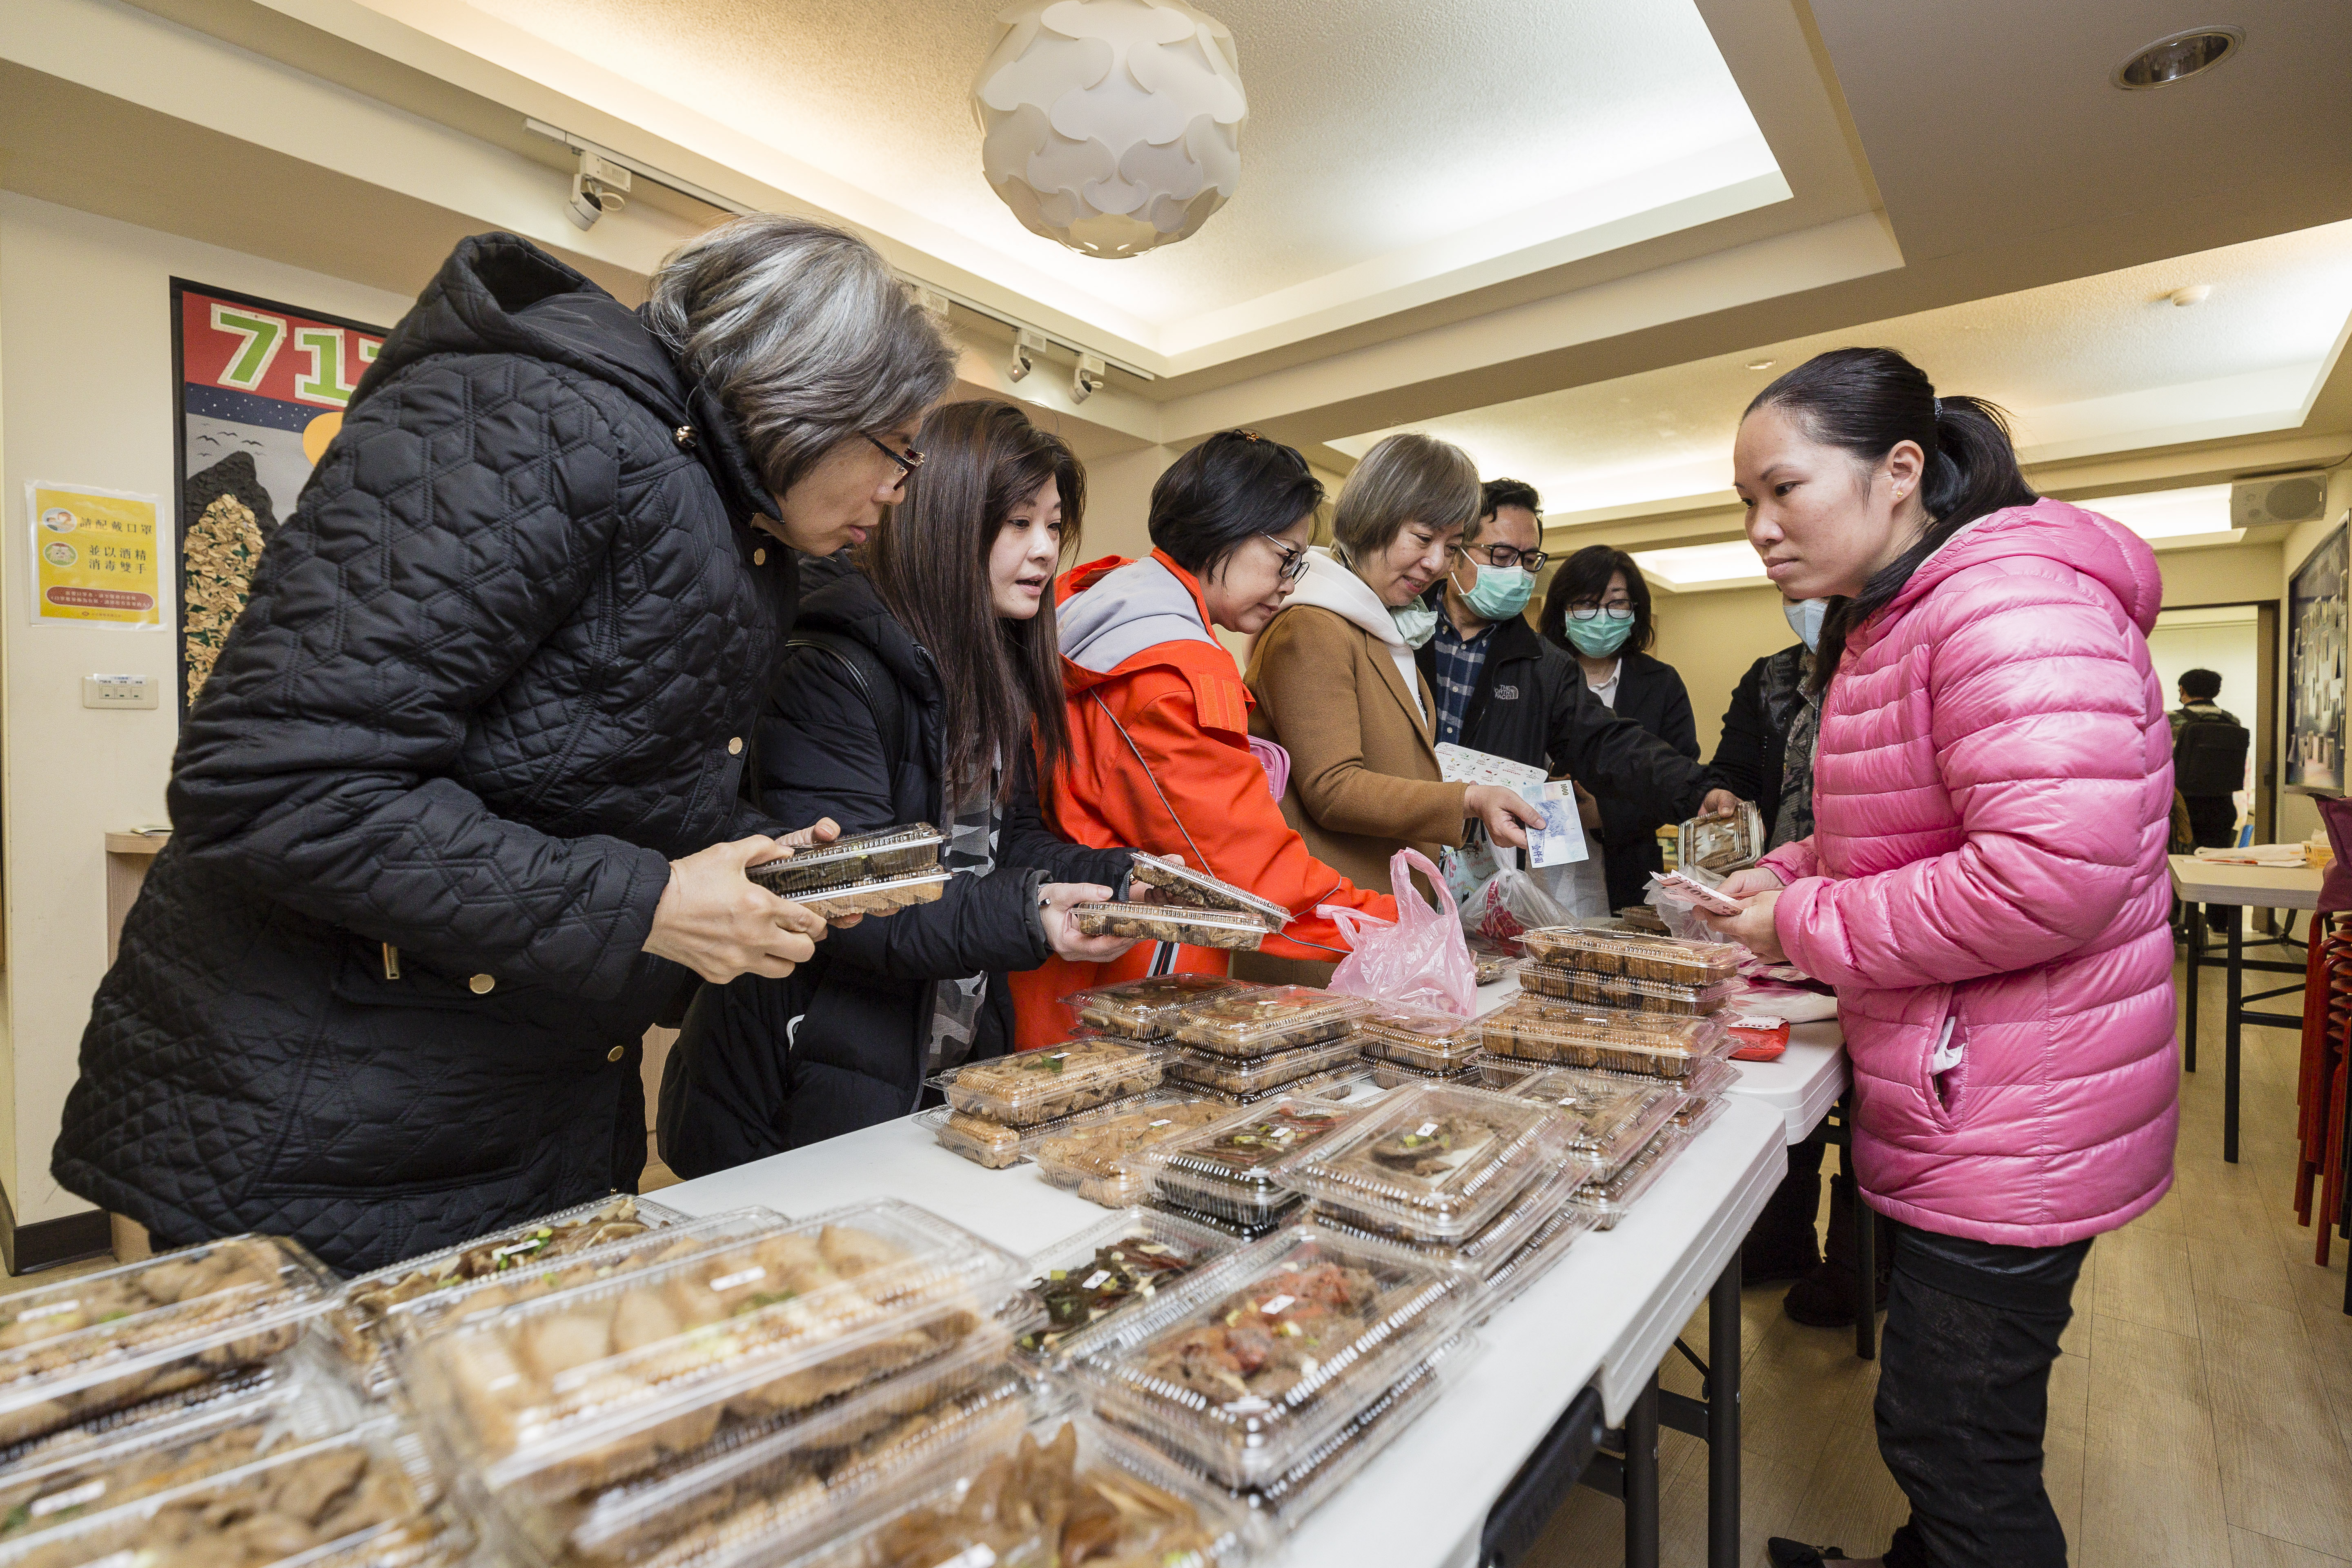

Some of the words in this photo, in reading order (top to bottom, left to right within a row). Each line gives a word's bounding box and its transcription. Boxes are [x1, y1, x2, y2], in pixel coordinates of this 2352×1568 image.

[89, 545, 146, 561] 並以酒精
[89, 559, 146, 574] 消毒雙手
[1561, 784, 1569, 795] 1000
[1683, 885, 1711, 901] 100
